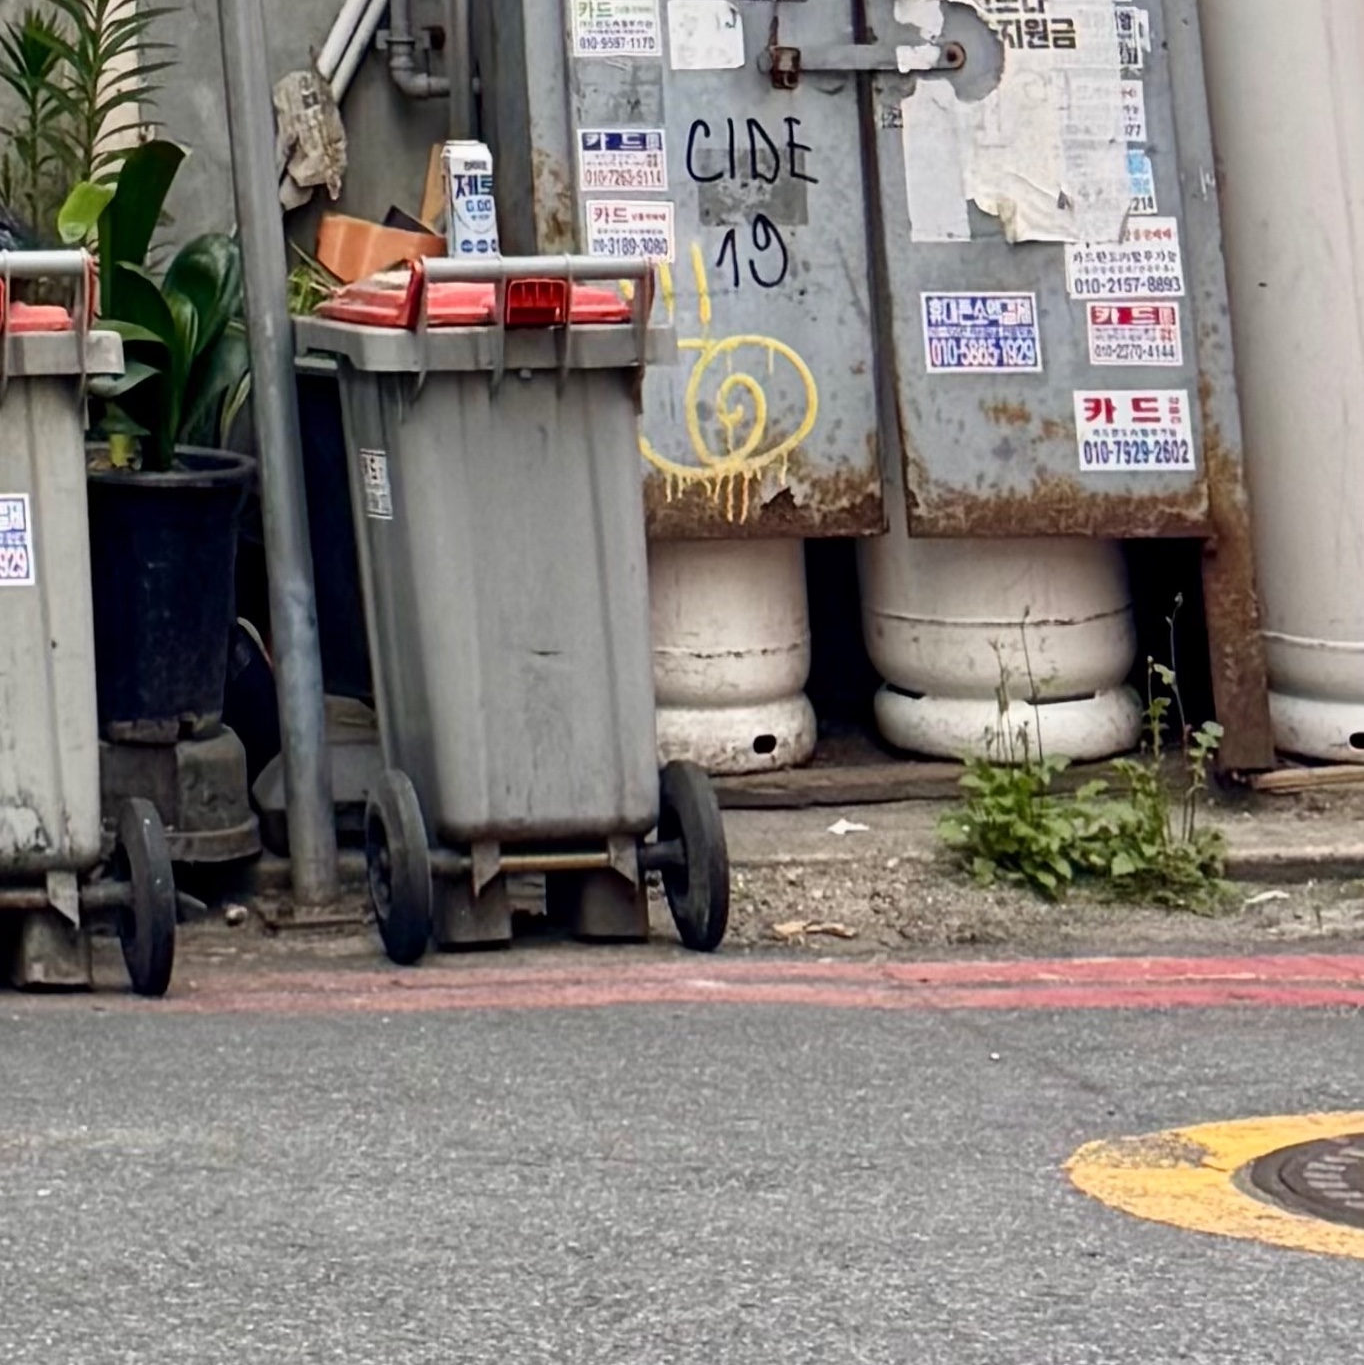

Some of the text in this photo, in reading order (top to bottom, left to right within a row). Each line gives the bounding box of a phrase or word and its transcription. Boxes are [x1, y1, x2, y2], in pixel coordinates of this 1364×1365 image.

[578, 1, 614, 19] 카드
[593, 206, 629, 224] 카드
[1093, 306, 1157, 325] 카드
[1083, 396, 1162, 424] 카드
